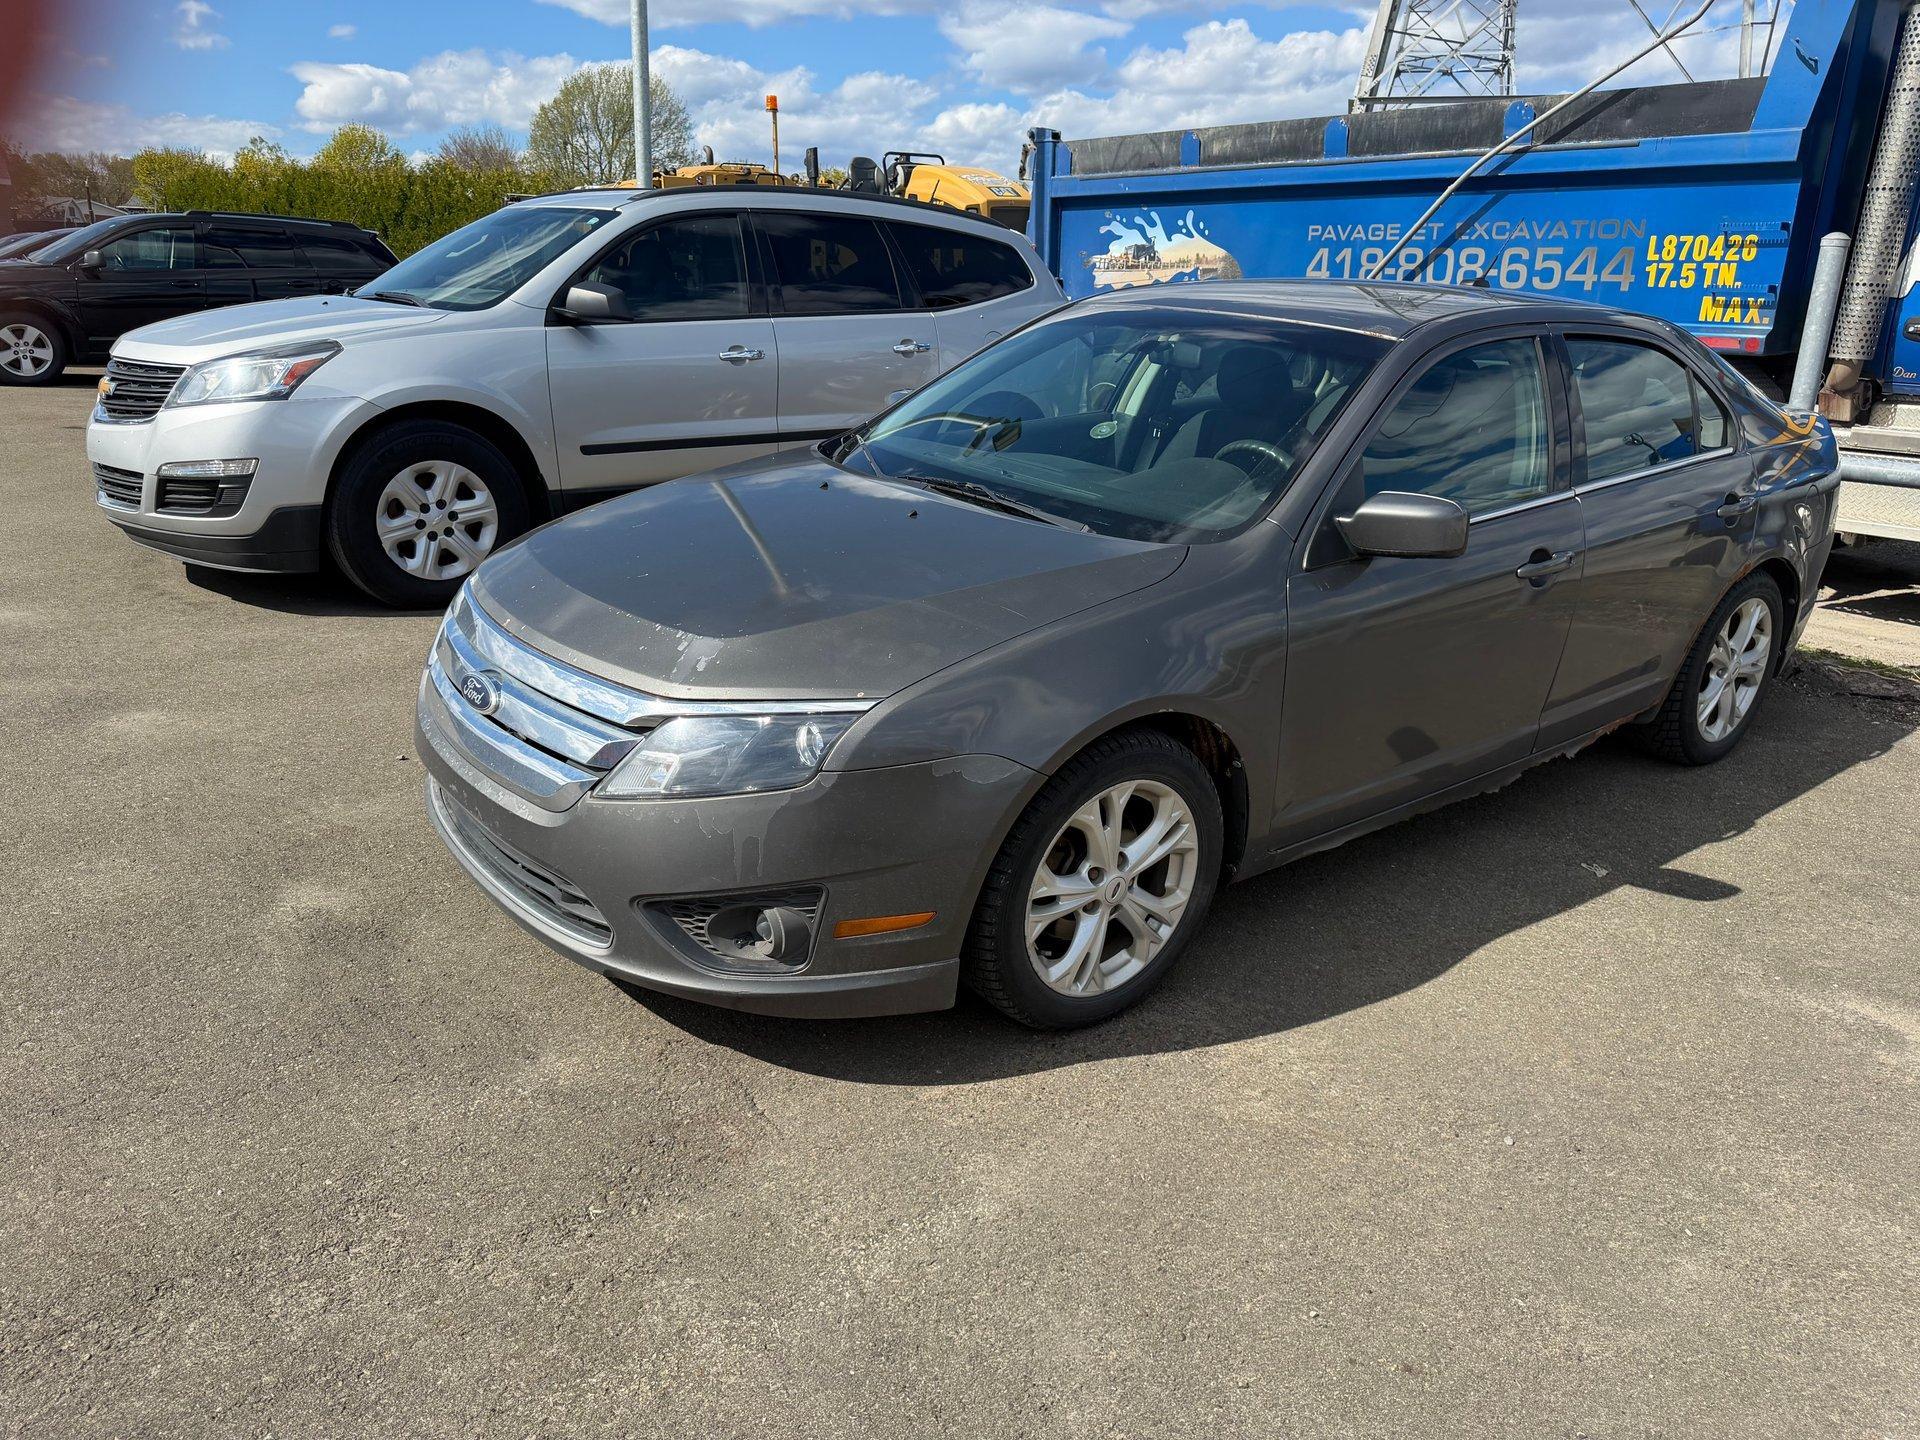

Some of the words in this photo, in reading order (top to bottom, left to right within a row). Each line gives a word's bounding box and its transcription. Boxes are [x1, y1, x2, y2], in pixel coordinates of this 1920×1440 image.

[990, 186, 1019, 197] CAT
[1307, 223, 1401, 241] PAVAGE
[1411, 222, 1444, 241] ET
[1455, 219, 1647, 241] EXCAVATION
[1305, 246, 1636, 291] 418-808-6544
[1645, 262, 1697, 288] 17.5
[1702, 262, 1742, 288] TN.
[1698, 296, 1770, 324] MAX.
[1893, 366, 1917, 379] Dan
[463, 677, 485, 705] Ford
